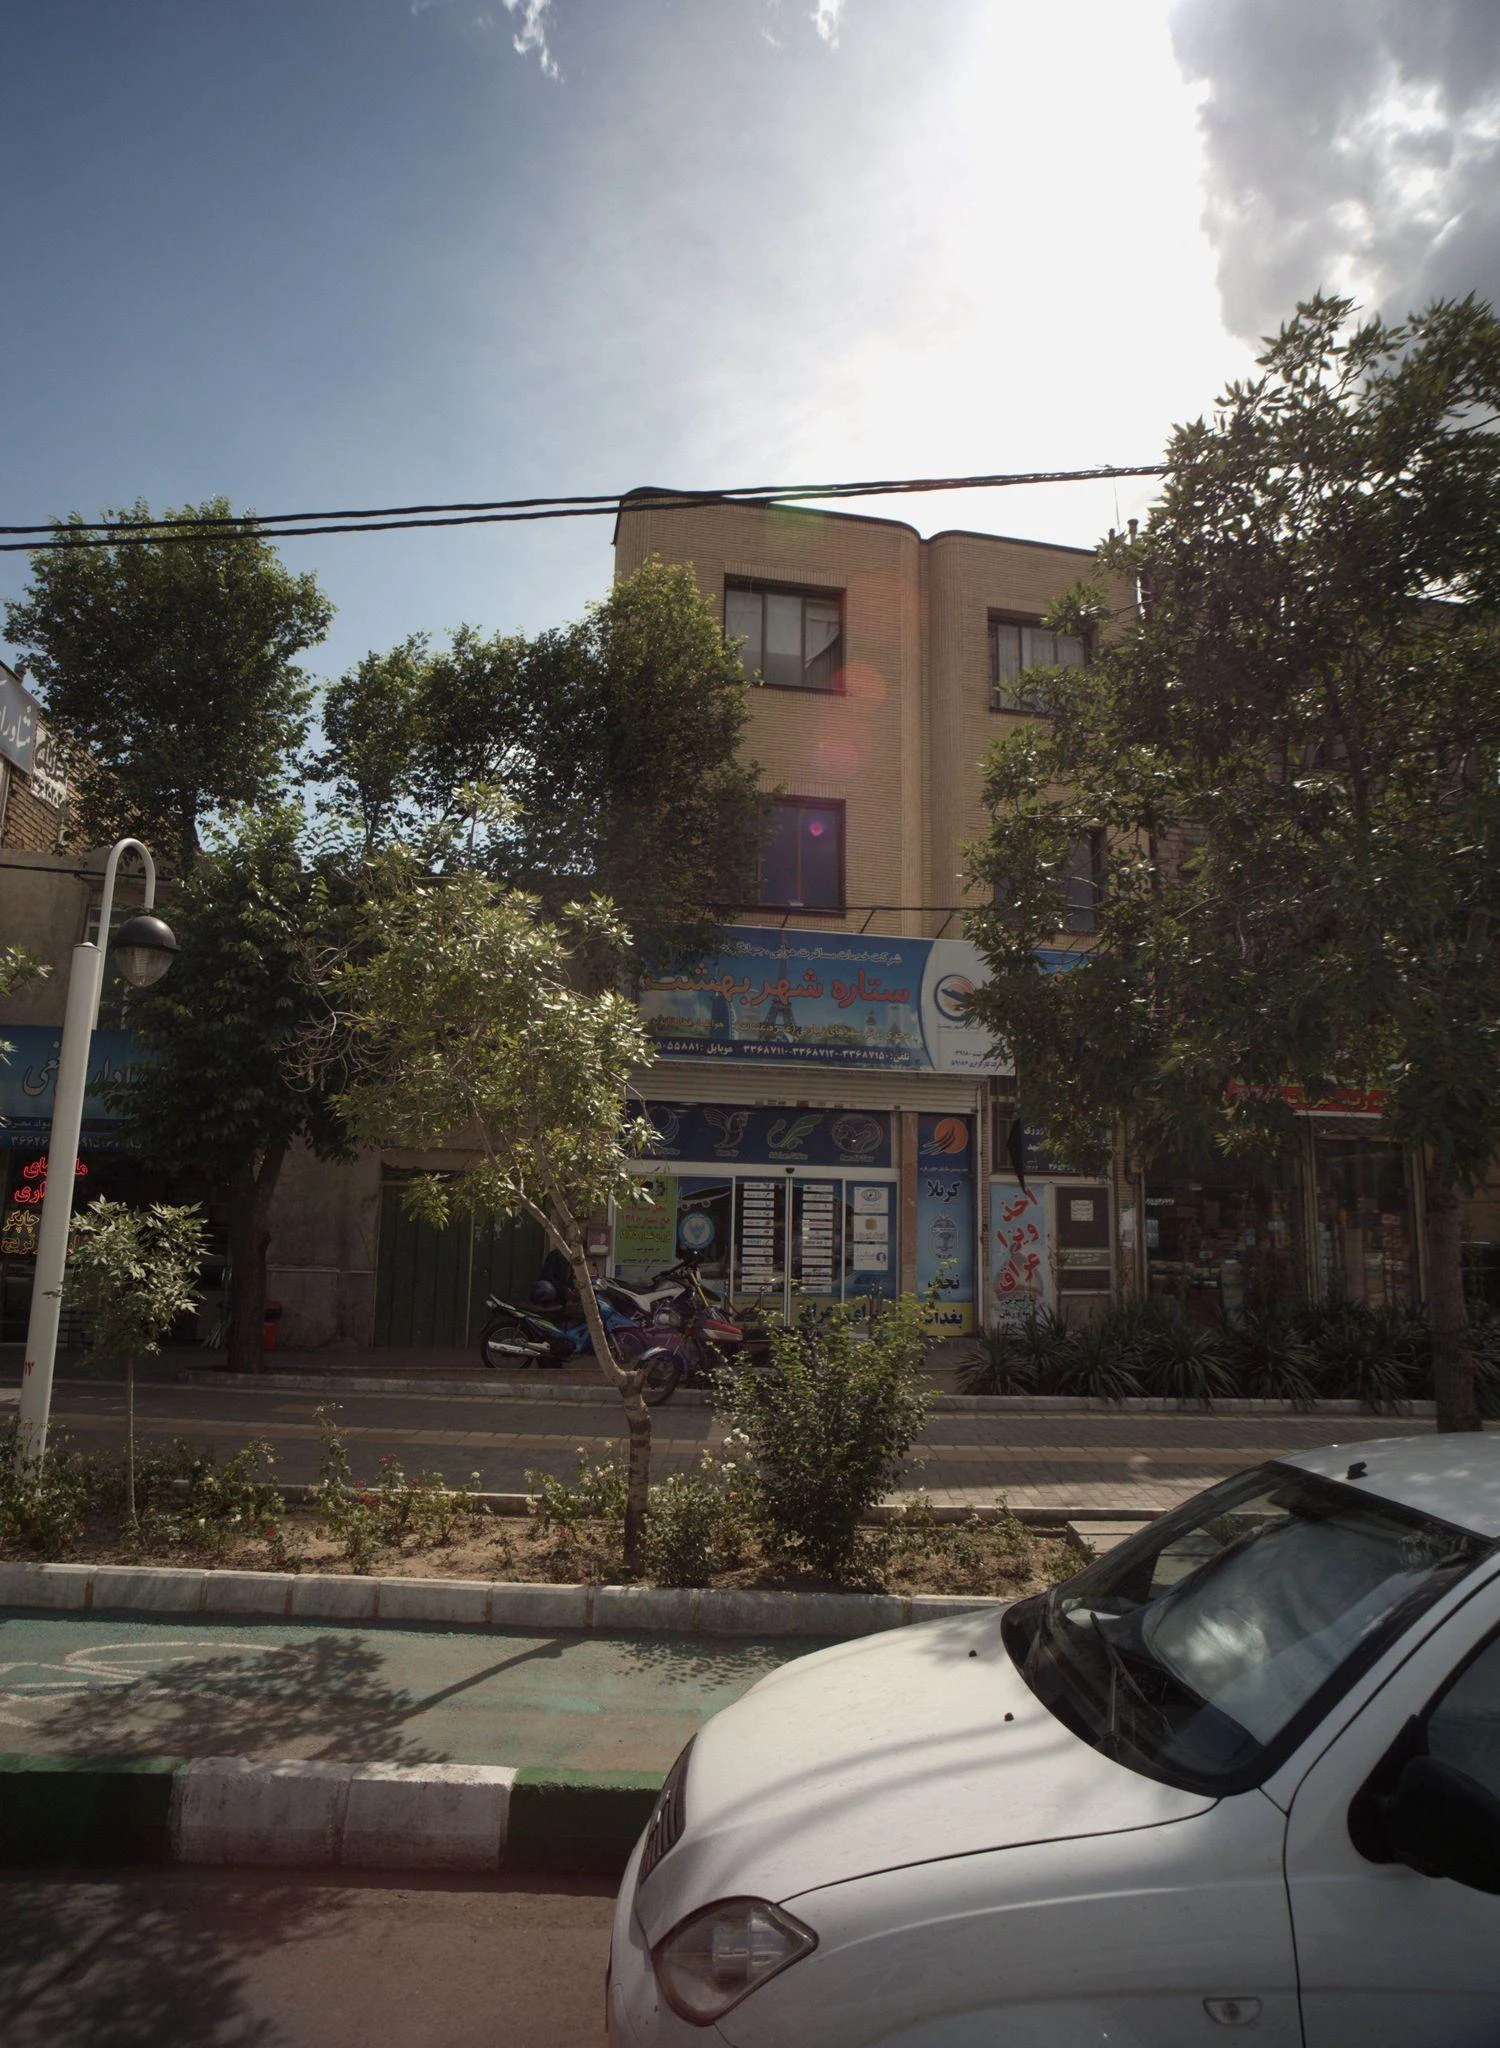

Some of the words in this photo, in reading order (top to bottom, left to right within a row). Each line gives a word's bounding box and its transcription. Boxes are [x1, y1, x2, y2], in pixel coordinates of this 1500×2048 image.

[643, 961, 752, 1006] بهشت
[751, 967, 824, 1008] شهر
[831, 968, 911, 1009] ستاره
[927, 1179, 961, 1202] کربلا
[1002, 1186, 1038, 1222] اخذ
[2, 1210, 41, 1234] چاپگر
[997, 1223, 1040, 1253] ویزا
[999, 1252, 1040, 1293] عراق
